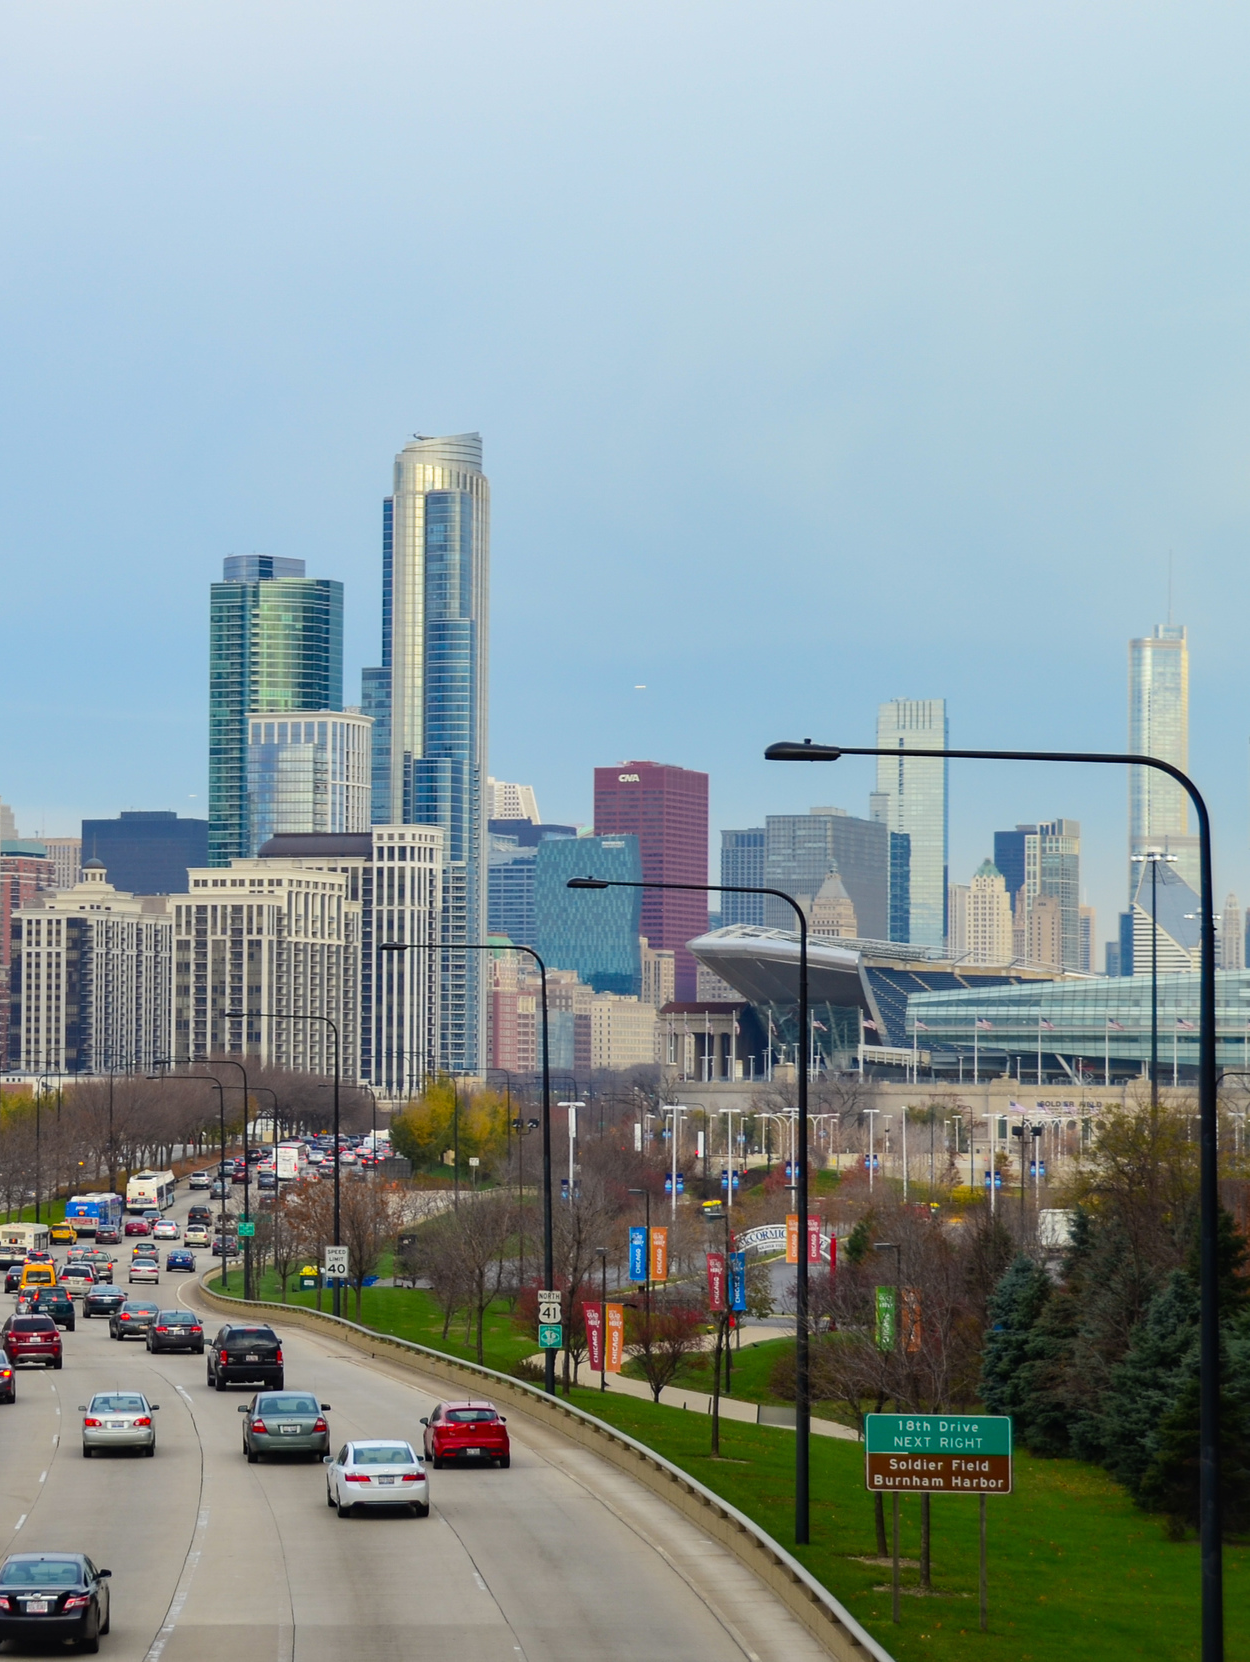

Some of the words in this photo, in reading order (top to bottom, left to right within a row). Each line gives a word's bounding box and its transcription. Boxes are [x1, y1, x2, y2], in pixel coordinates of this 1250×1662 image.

[618, 774, 640, 782] CNA
[738, 1229, 786, 1246] McCORMIC
[328, 1264, 346, 1273] 40
[542, 1307, 556, 1319] 41
[898, 1420, 931, 1432] 18th
[940, 1422, 978, 1432] Drive
[894, 1437, 931, 1447] NEXT
[940, 1438, 983, 1448] RIGHT
[889, 1459, 943, 1470] Soldier
[952, 1460, 989, 1471] Field
[874, 1475, 943, 1486] Burnham
[952, 1476, 1004, 1488] Harbor
